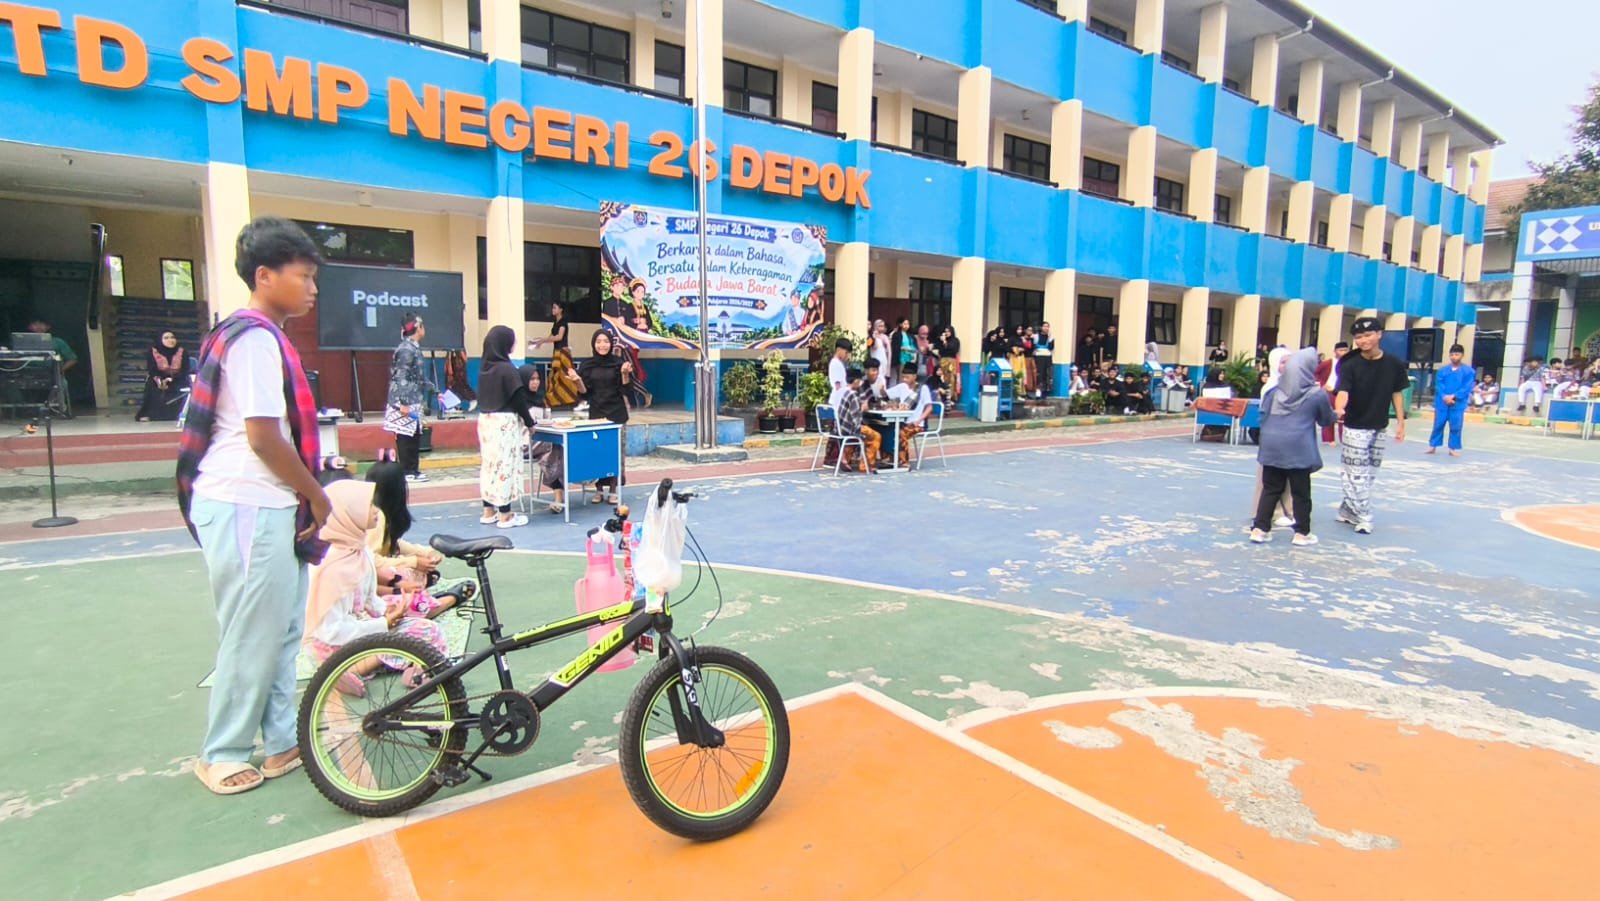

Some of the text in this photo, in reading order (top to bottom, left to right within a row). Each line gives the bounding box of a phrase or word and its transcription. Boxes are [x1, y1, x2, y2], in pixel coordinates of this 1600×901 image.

[181, 38, 370, 124] SMP
[387, 77, 629, 169] NEGERI
[648, 131, 718, 182] 26
[730, 144, 872, 208] DEPOK
[675, 218, 771, 240] SMP egeri 26 Depok
[715, 244, 743, 258] dalam
[648, 259, 694, 277] Bersatu
[729, 261, 792, 283] Keberagaman
[716, 276, 744, 291] Jawa
[747, 279, 778, 296] Barat
[353, 290, 429, 307] Podcast
[558, 624, 624, 684] GENIO
